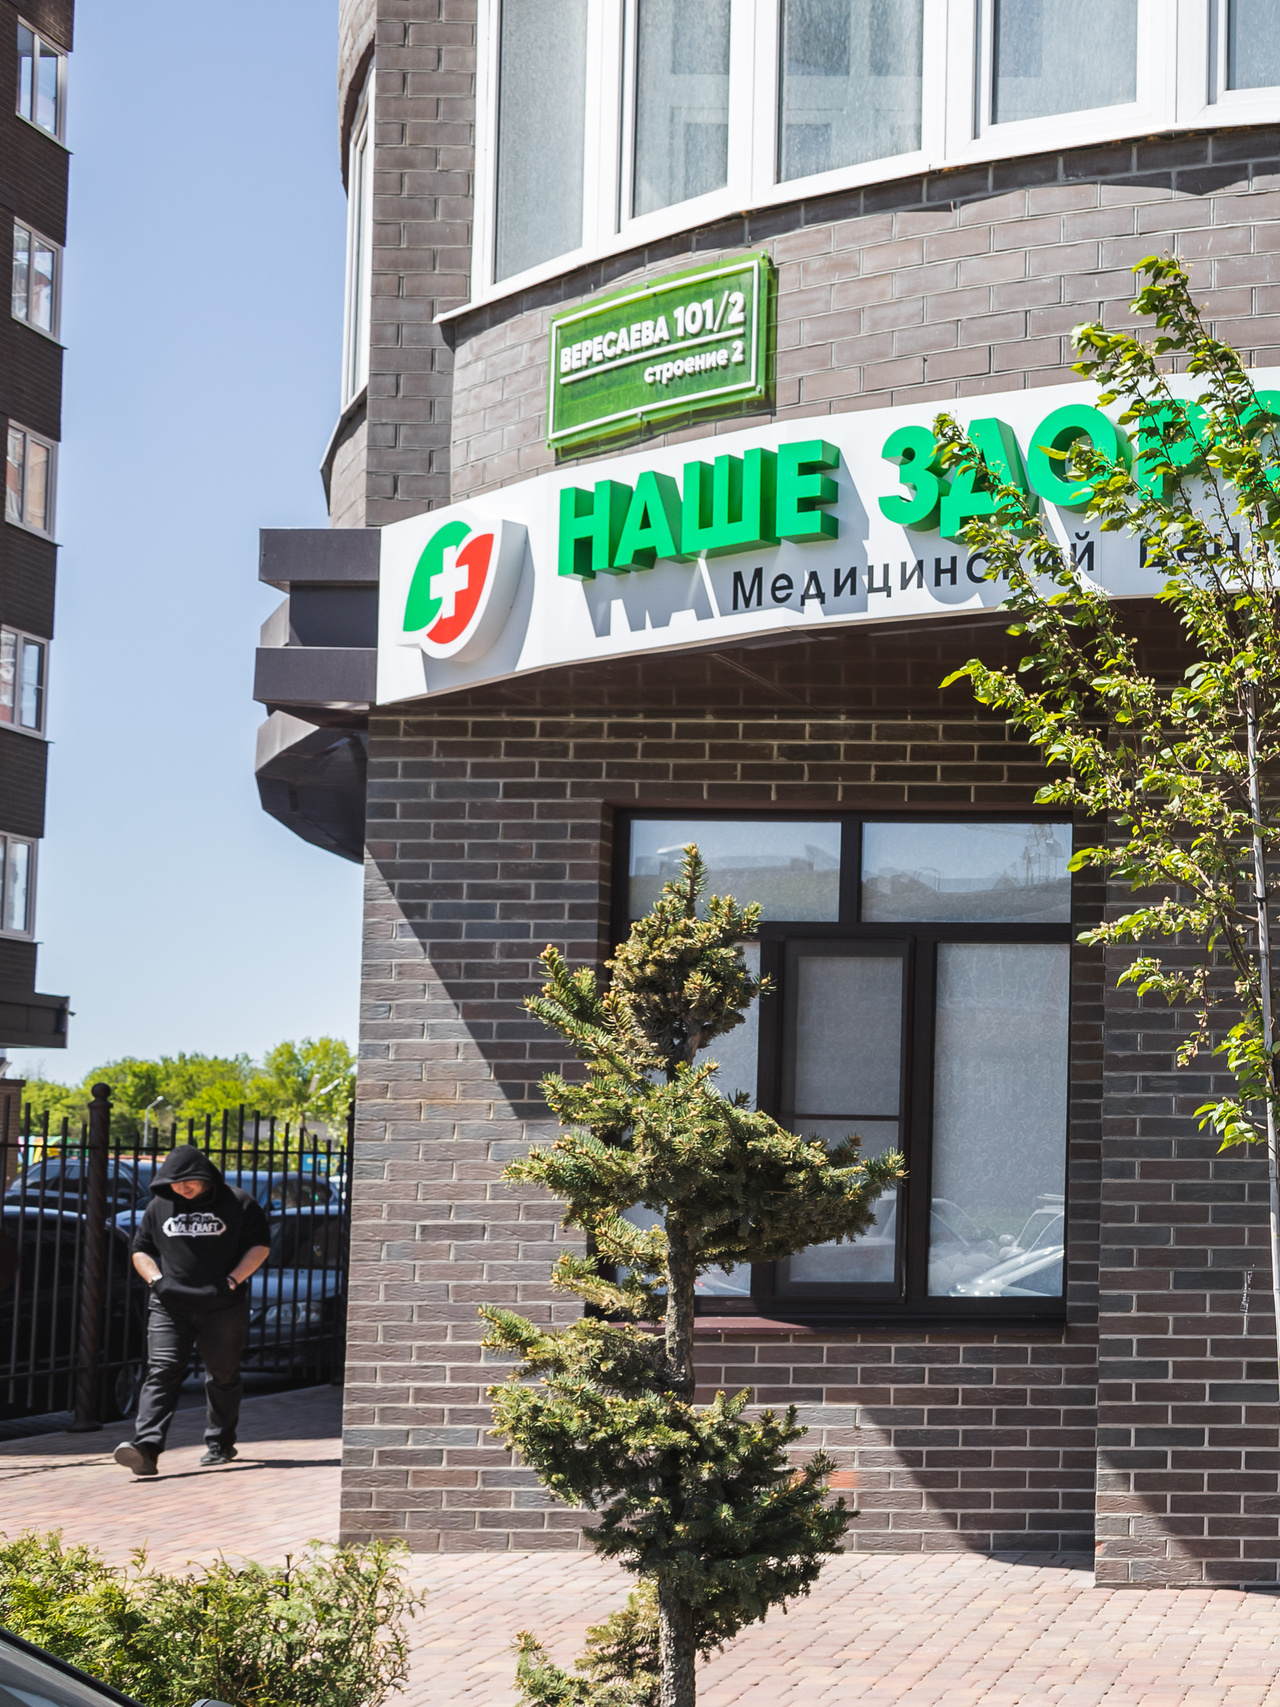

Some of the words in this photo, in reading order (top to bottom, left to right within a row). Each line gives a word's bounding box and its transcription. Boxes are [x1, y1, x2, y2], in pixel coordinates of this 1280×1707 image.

[560, 315, 670, 373] ВЕРЕСАЕВА
[673, 290, 745, 338] 101/2
[644, 348, 729, 385] строение
[731, 340, 744, 363] 2
[559, 439, 839, 580] НАШЕ
